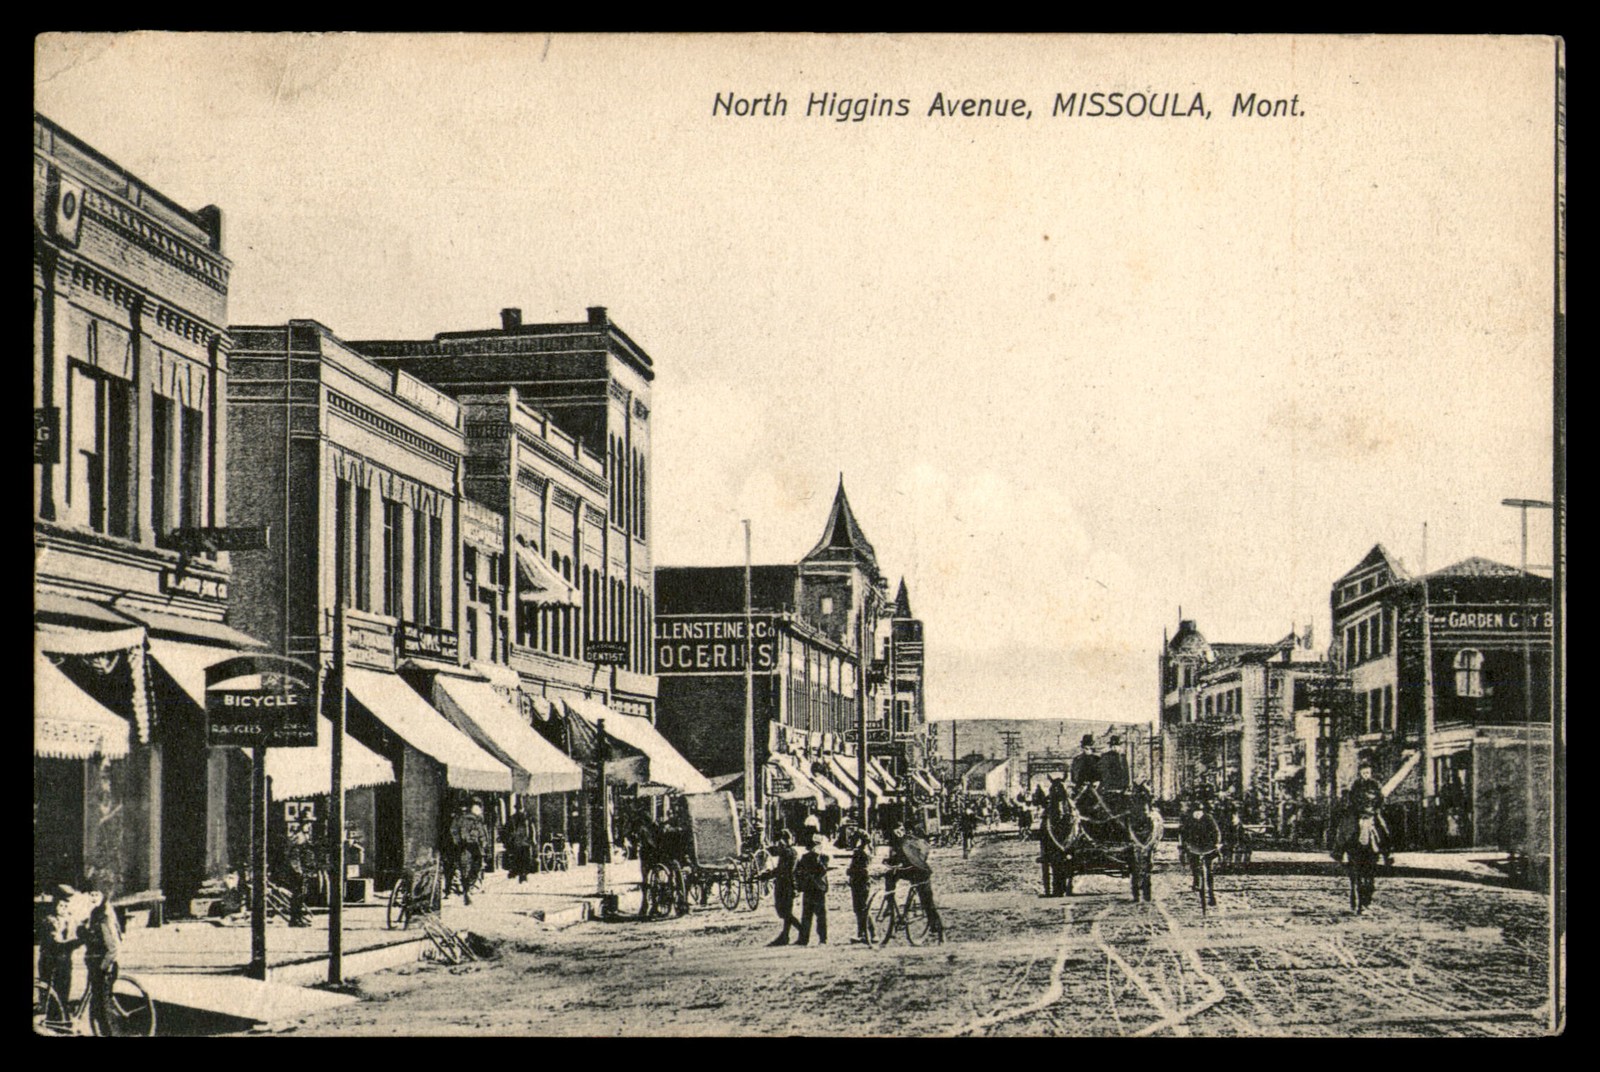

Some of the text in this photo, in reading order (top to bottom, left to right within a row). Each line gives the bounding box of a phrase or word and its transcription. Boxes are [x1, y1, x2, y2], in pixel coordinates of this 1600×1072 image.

[1449, 611, 1503, 628] GARDEN
[1509, 612, 1539, 628] CY
[223, 694, 298, 707] BICYCLE
